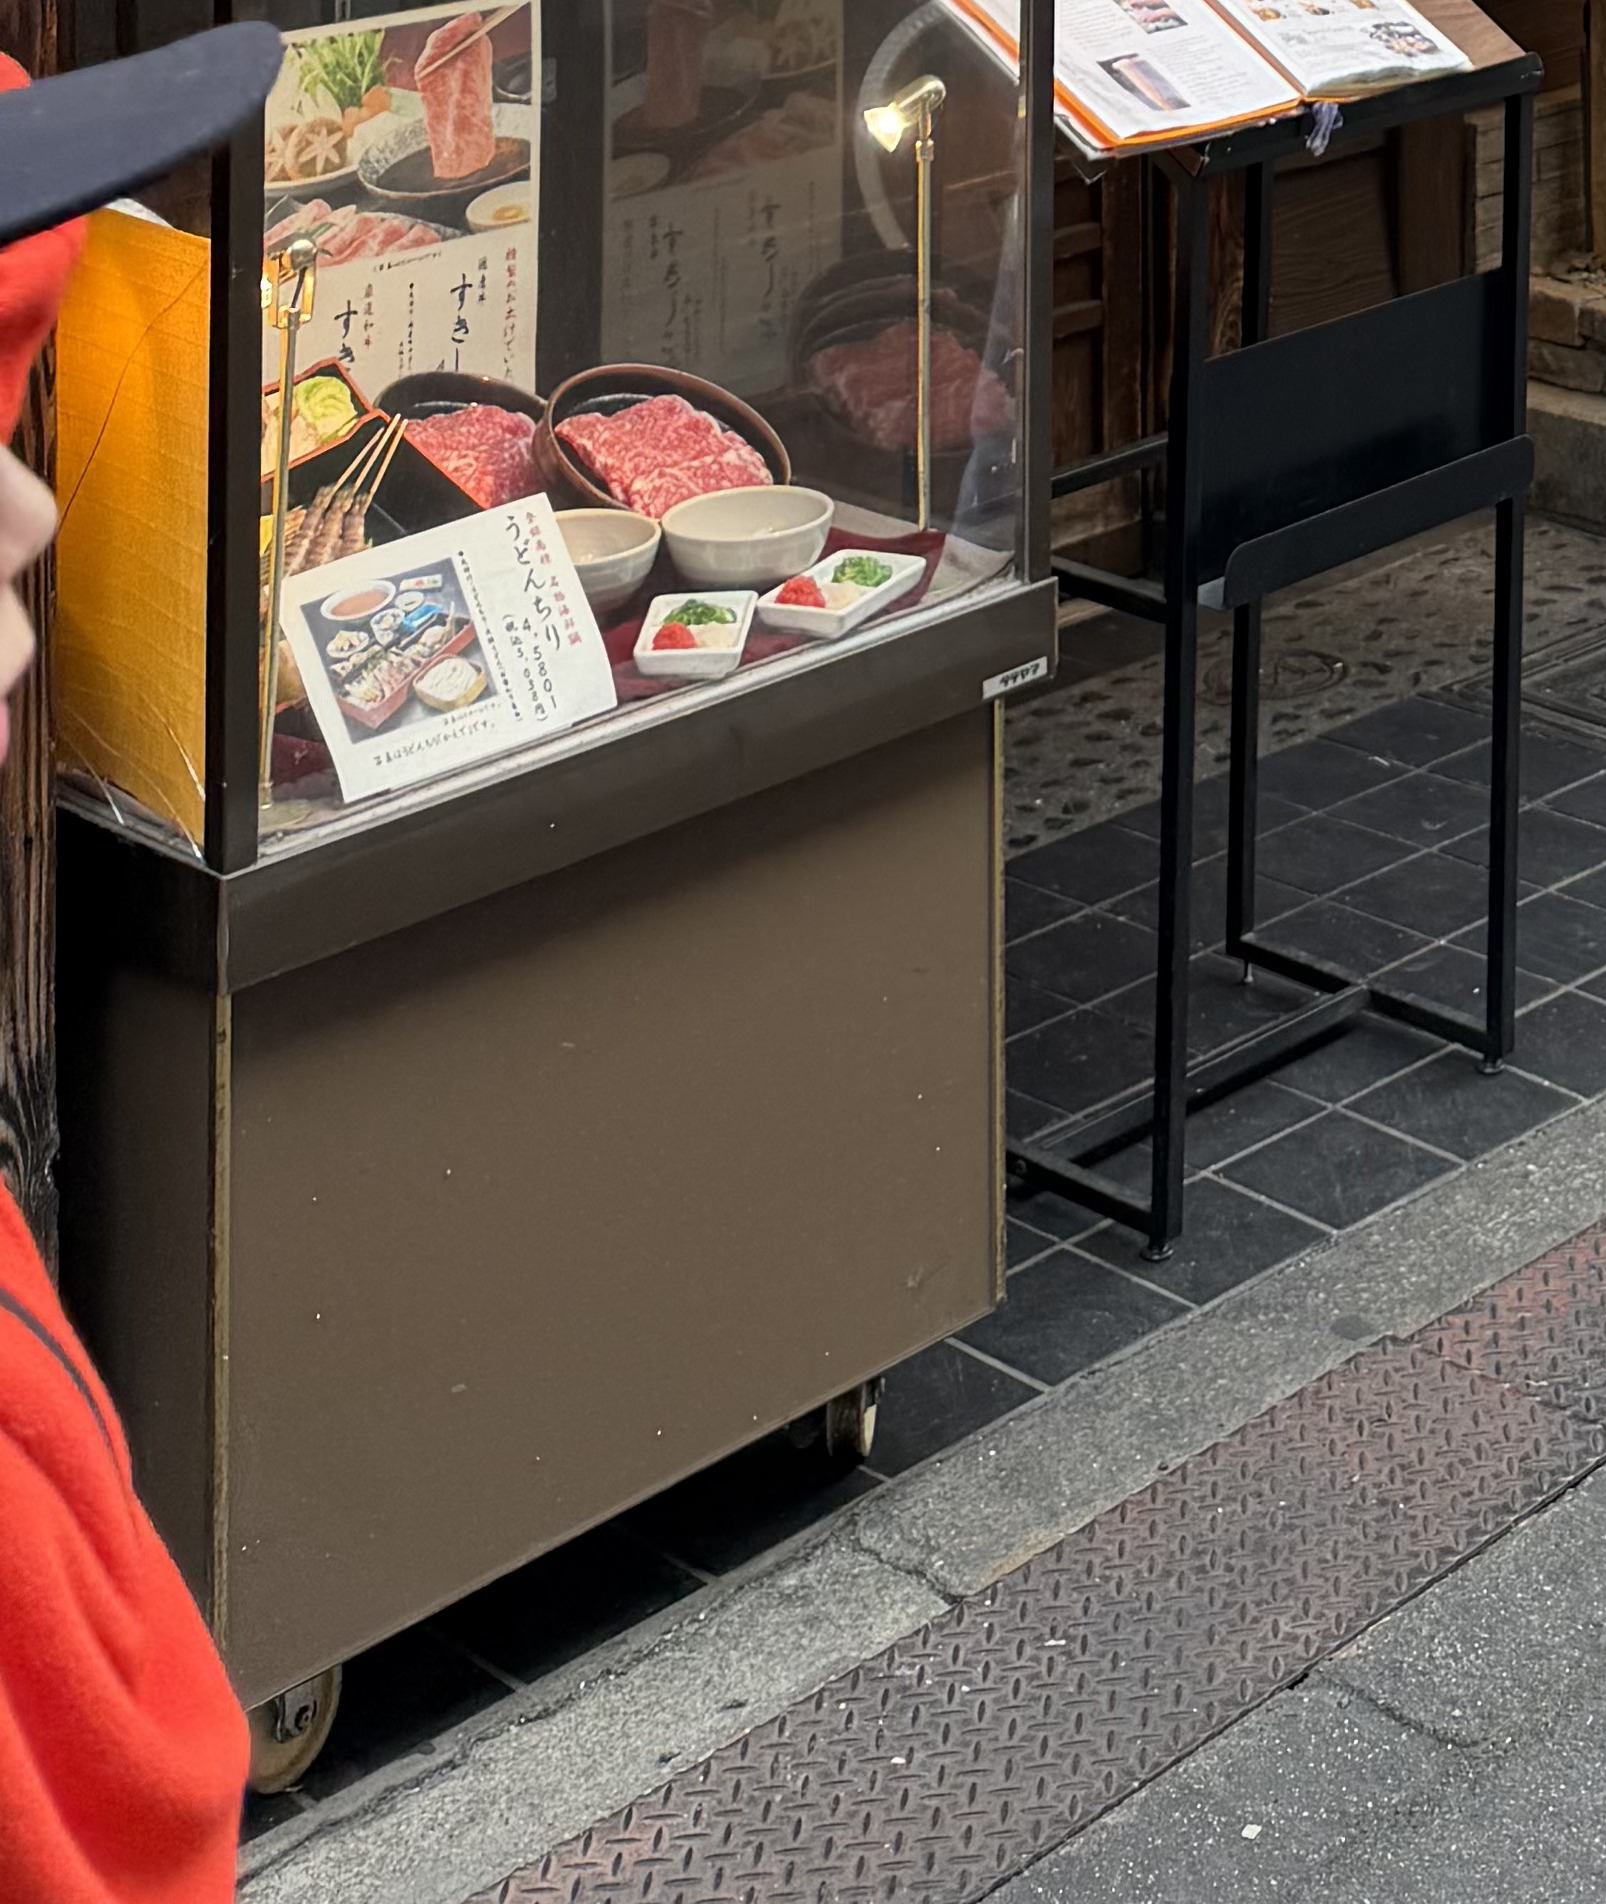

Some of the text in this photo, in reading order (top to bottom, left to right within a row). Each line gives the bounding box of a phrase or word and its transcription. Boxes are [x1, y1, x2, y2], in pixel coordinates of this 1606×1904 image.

[505, 515, 561, 651] うどんちり
